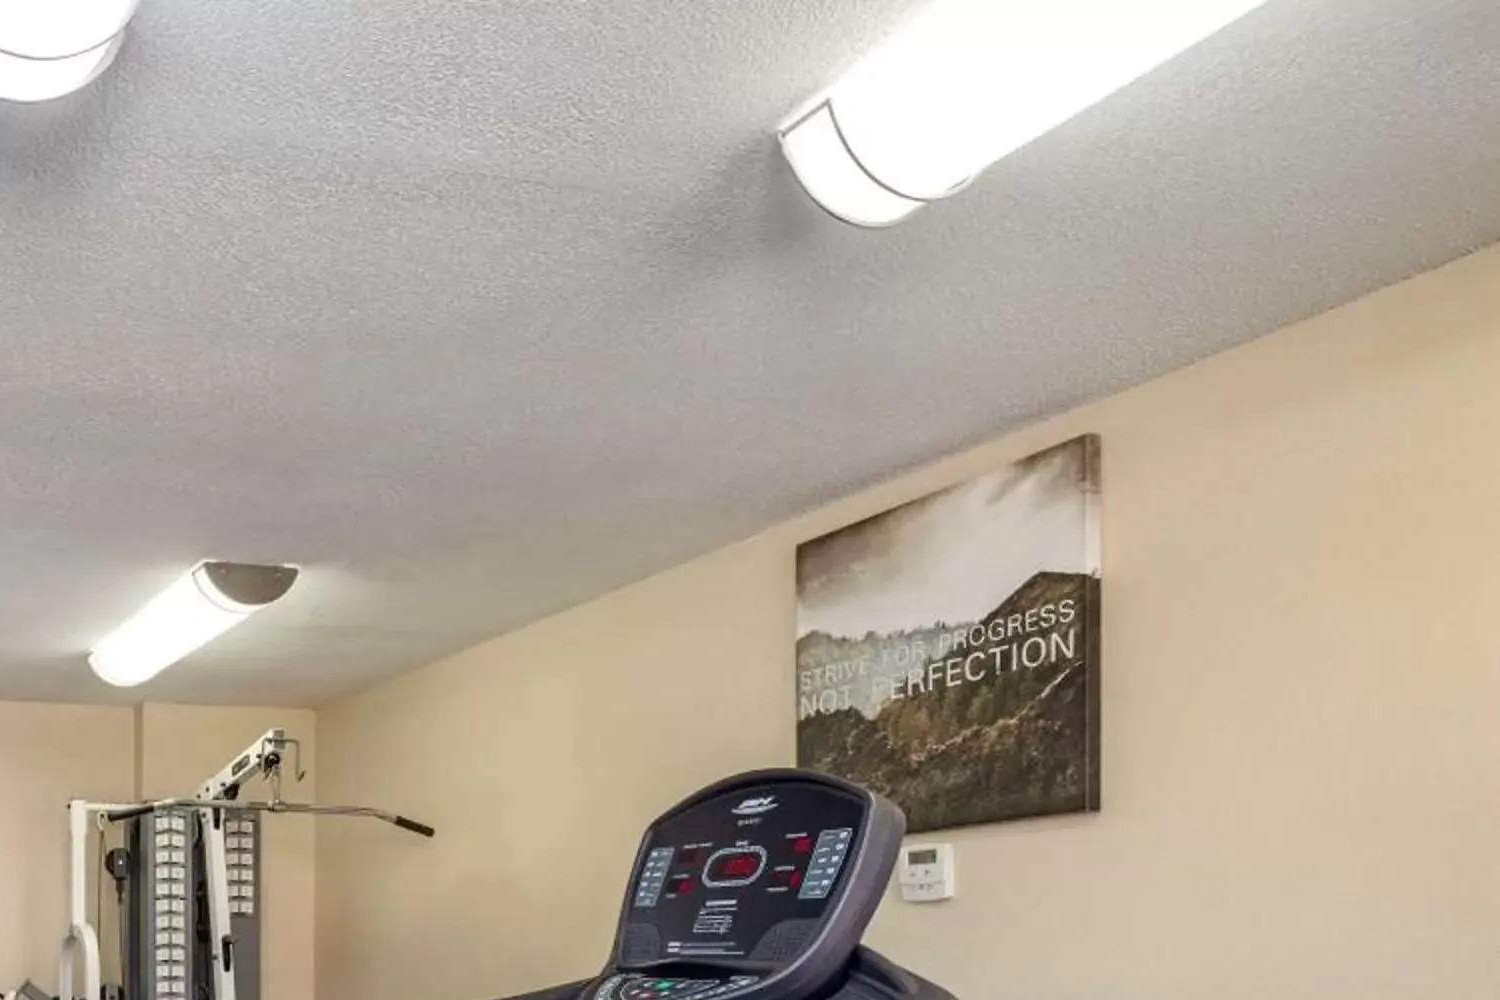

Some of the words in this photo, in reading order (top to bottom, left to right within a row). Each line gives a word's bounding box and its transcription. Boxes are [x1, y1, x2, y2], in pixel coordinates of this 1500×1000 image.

[800, 656, 869, 692] STRIVE
[882, 641, 926, 669] FOR
[938, 599, 1076, 652] PROGRESS
[800, 684, 852, 720] NOT
[871, 629, 1077, 706] PERFECTION
